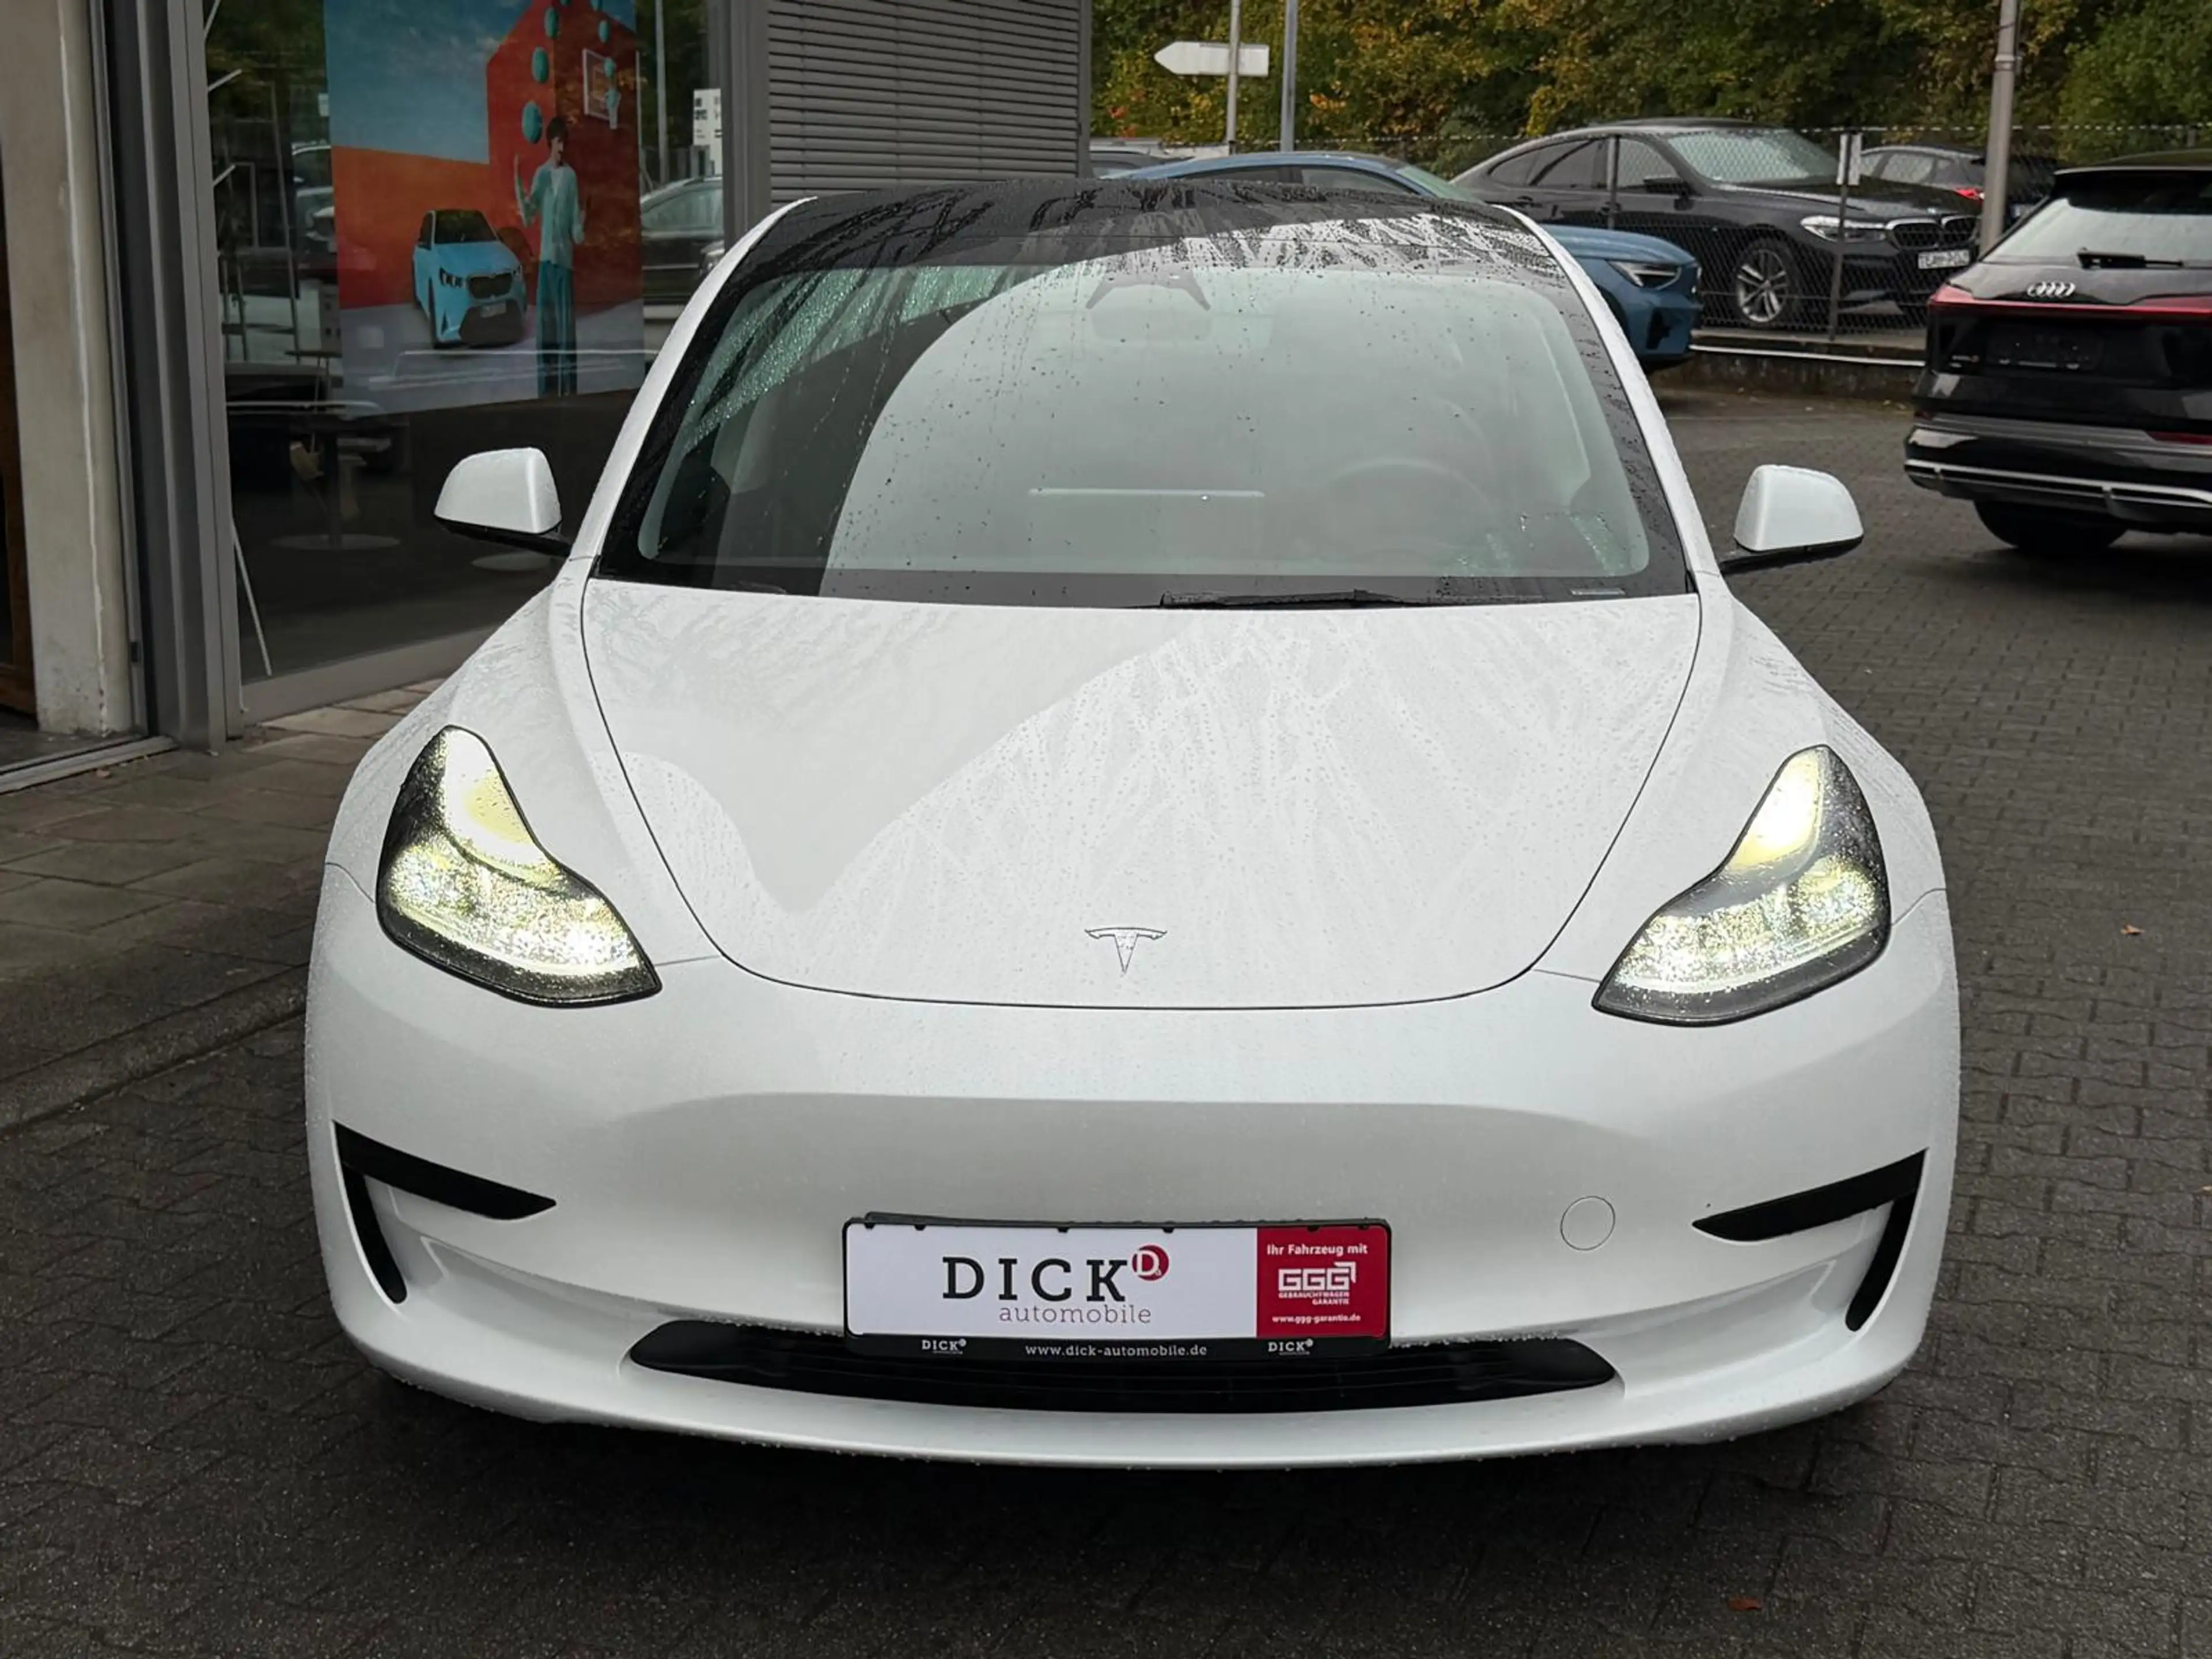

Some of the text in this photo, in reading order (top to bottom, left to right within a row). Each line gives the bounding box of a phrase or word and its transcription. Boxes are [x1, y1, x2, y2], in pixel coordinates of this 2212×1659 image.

[1267, 1243, 1368, 1257] Ihr Fahrzeug mit
[943, 1256, 1127, 1302] DICK
[1278, 1268, 1350, 1291] GGG
[1312, 1298, 1350, 1306] GARANTIE
[999, 1304, 1152, 1324] automobile
[922, 1339, 959, 1351] DICK
[1025, 1344, 1208, 1357] www.dick-automobile.de
[1268, 1341, 1305, 1352] DICK
